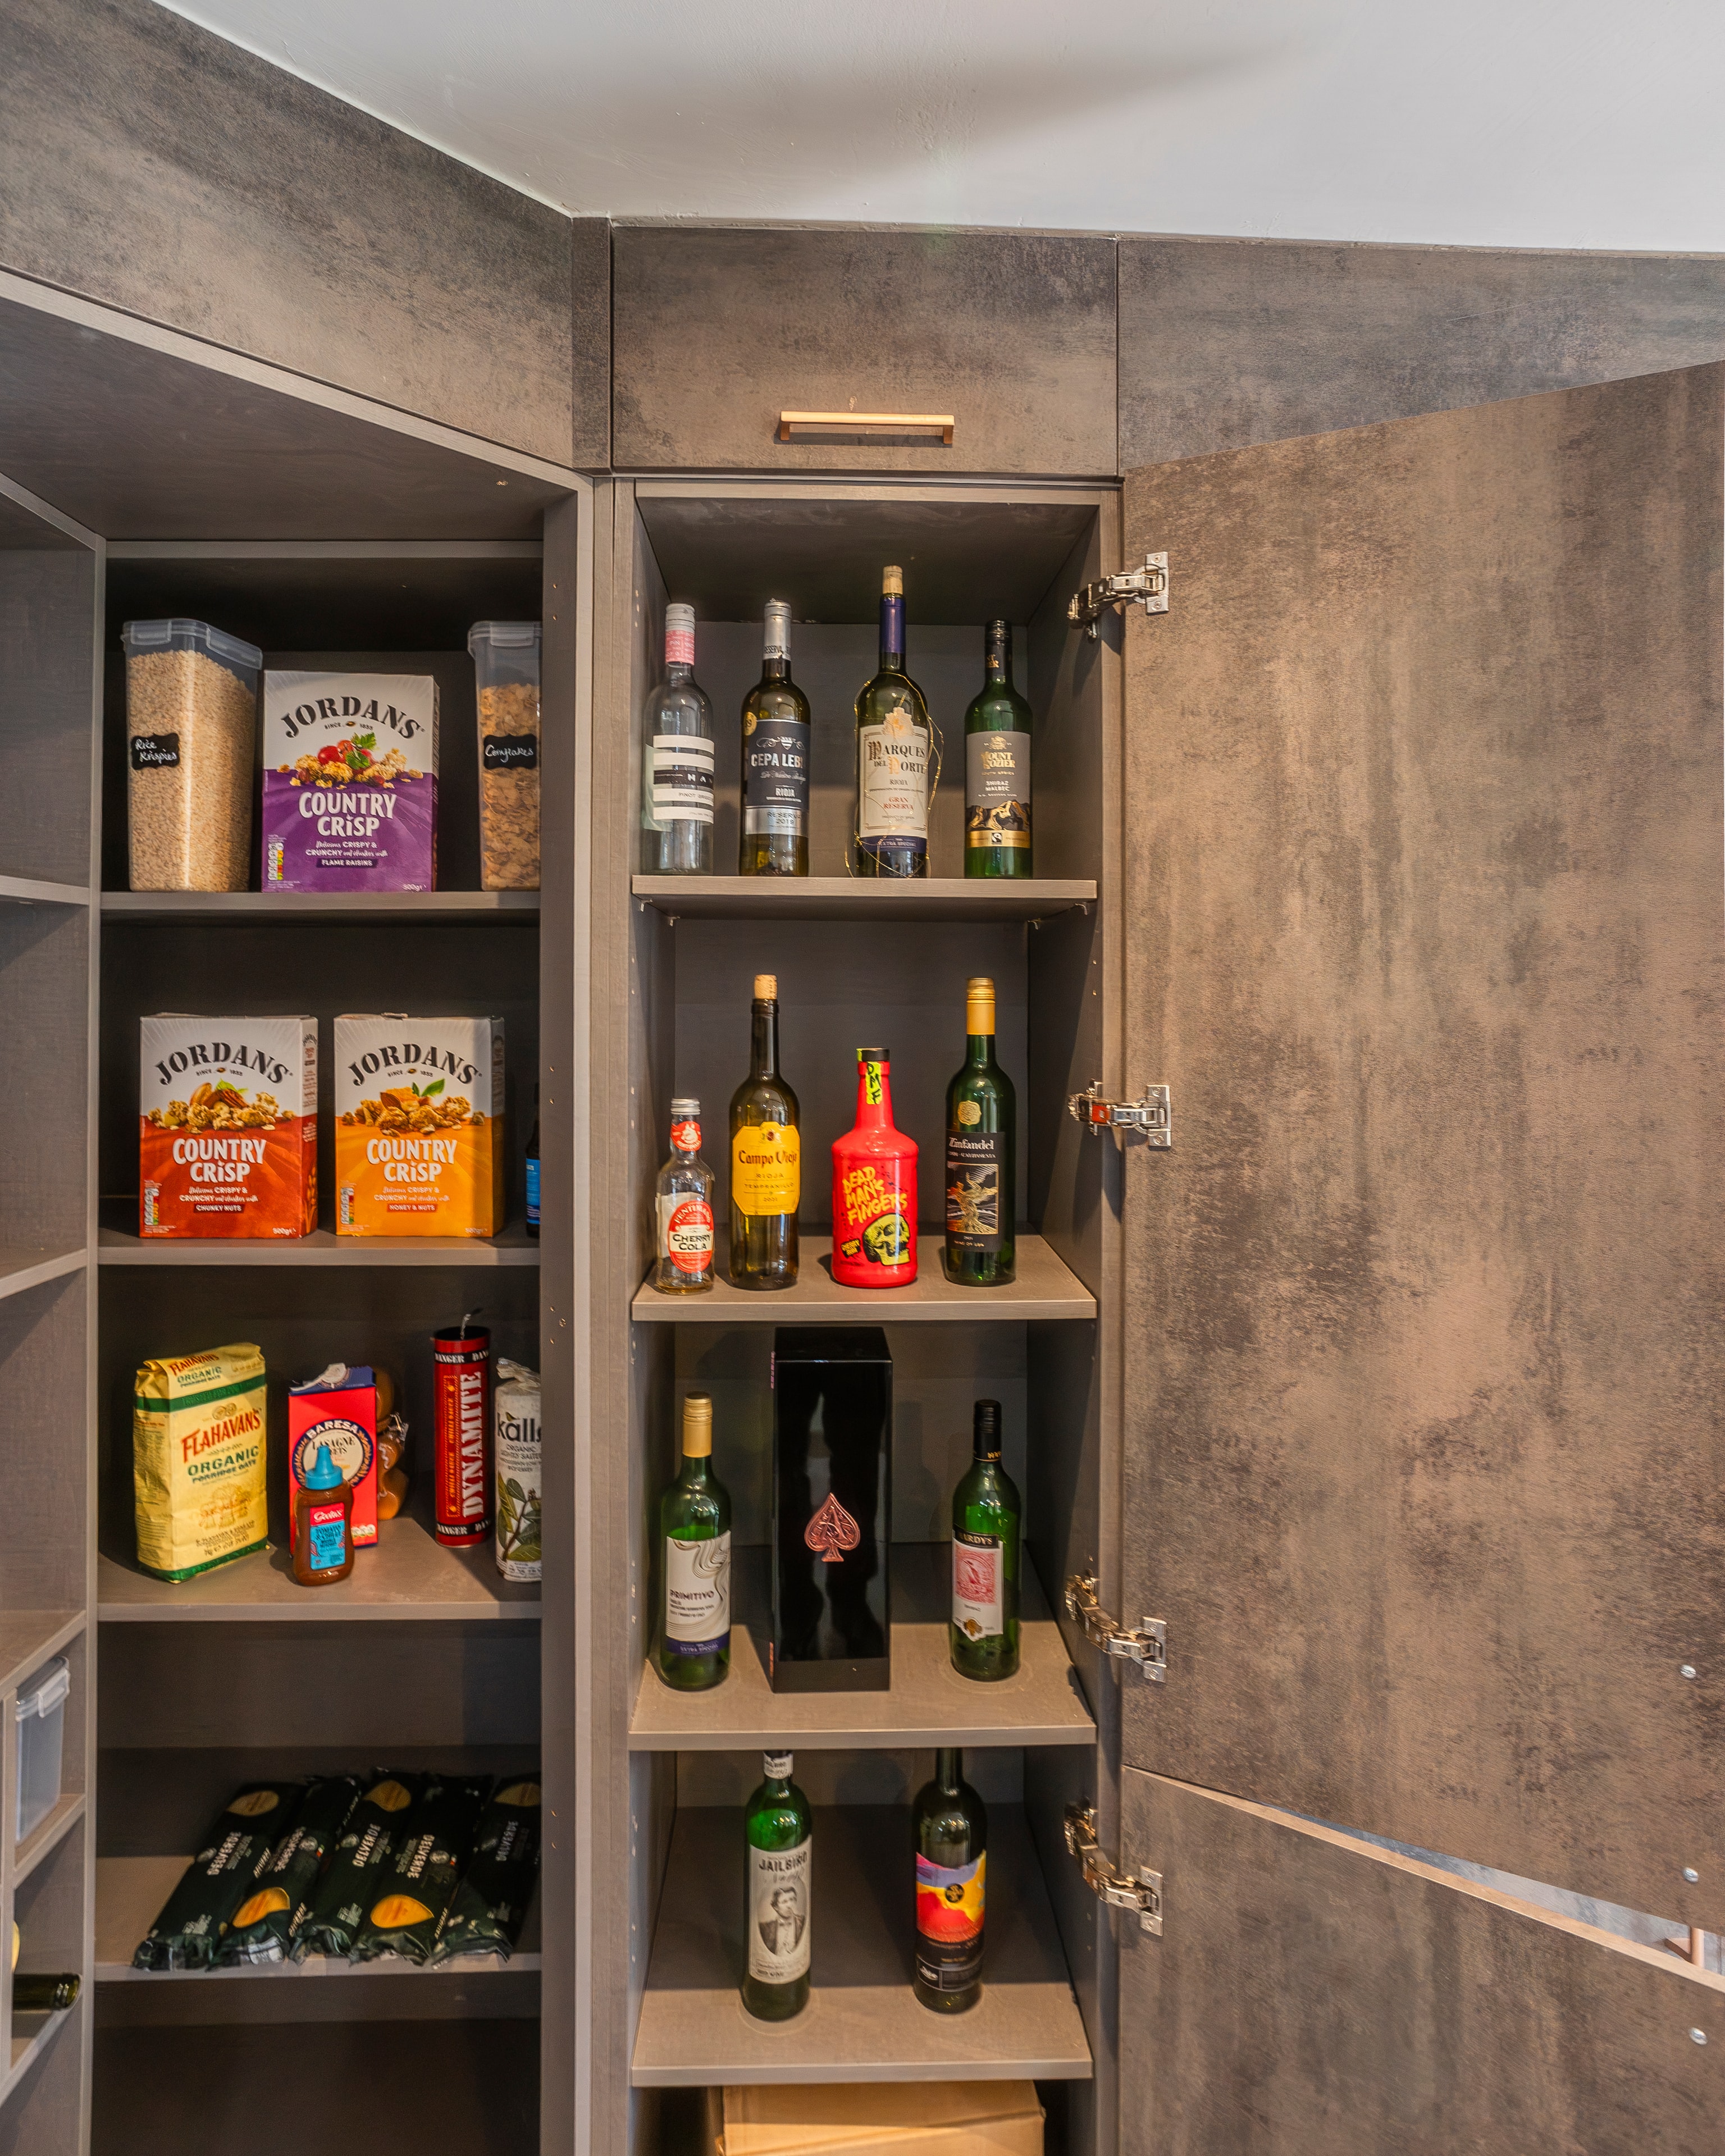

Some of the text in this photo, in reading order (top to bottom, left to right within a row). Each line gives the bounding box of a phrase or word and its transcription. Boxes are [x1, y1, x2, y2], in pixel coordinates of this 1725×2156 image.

[281, 696, 421, 739] JORDANS
[135, 739, 157, 750] Rice
[868, 741, 925, 761] MARQUES
[751, 753, 780, 767] CEPA
[775, 787, 796, 797] RIOJA
[299, 792, 397, 819] COUNTRY
[155, 1042, 290, 1085] JORDANS
[348, 1043, 479, 1086] JORDANS
[172, 1138, 267, 1164] COUNTRY
[367, 1139, 458, 1164] COUNTRY
[949, 1137, 994, 1150] Zinfandel
[738, 1150, 773, 1168] Campo
[842, 1166, 876, 1195] DEAD
[847, 1193, 908, 1226] FINGERS
[673, 1234, 711, 1243] CHERRY
[177, 1365, 223, 1383] ORGANIC
[306, 1419, 359, 1440] BARESA
[460, 1371, 483, 1518] DYNAMITE
[188, 1445, 259, 1476] ORGANIC
[959, 1533, 993, 1545] ARDYS
[669, 1589, 715, 1601] PRIMITIVO
[352, 1824, 382, 1868] DELVERDE
[407, 1834, 435, 1879] DELVERDE
